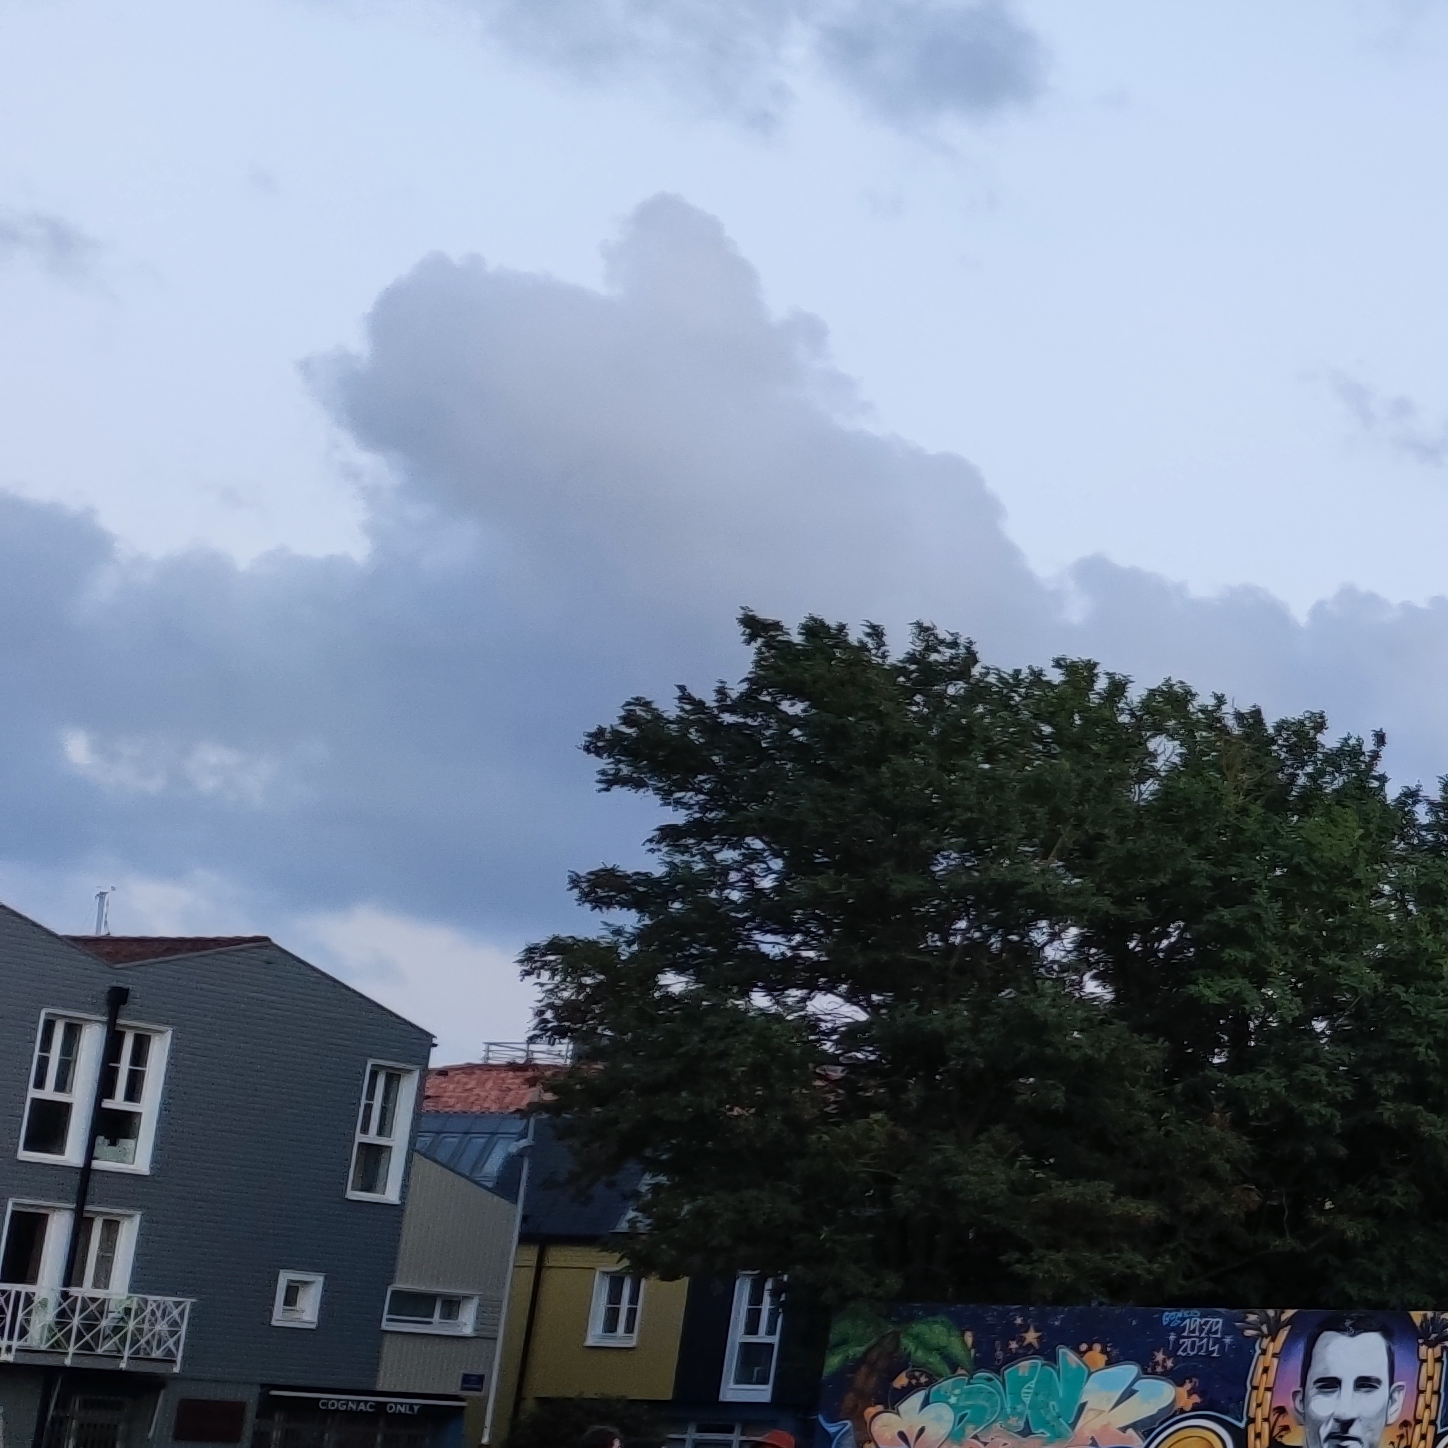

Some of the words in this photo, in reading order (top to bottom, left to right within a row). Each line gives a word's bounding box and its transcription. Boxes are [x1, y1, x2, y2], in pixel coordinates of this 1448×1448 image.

[1180, 1317, 1223, 1339] 1979
[1176, 1338, 1221, 1357] 2014
[318, 1399, 376, 1413] COGNAC
[386, 1403, 422, 1415] ONLY
